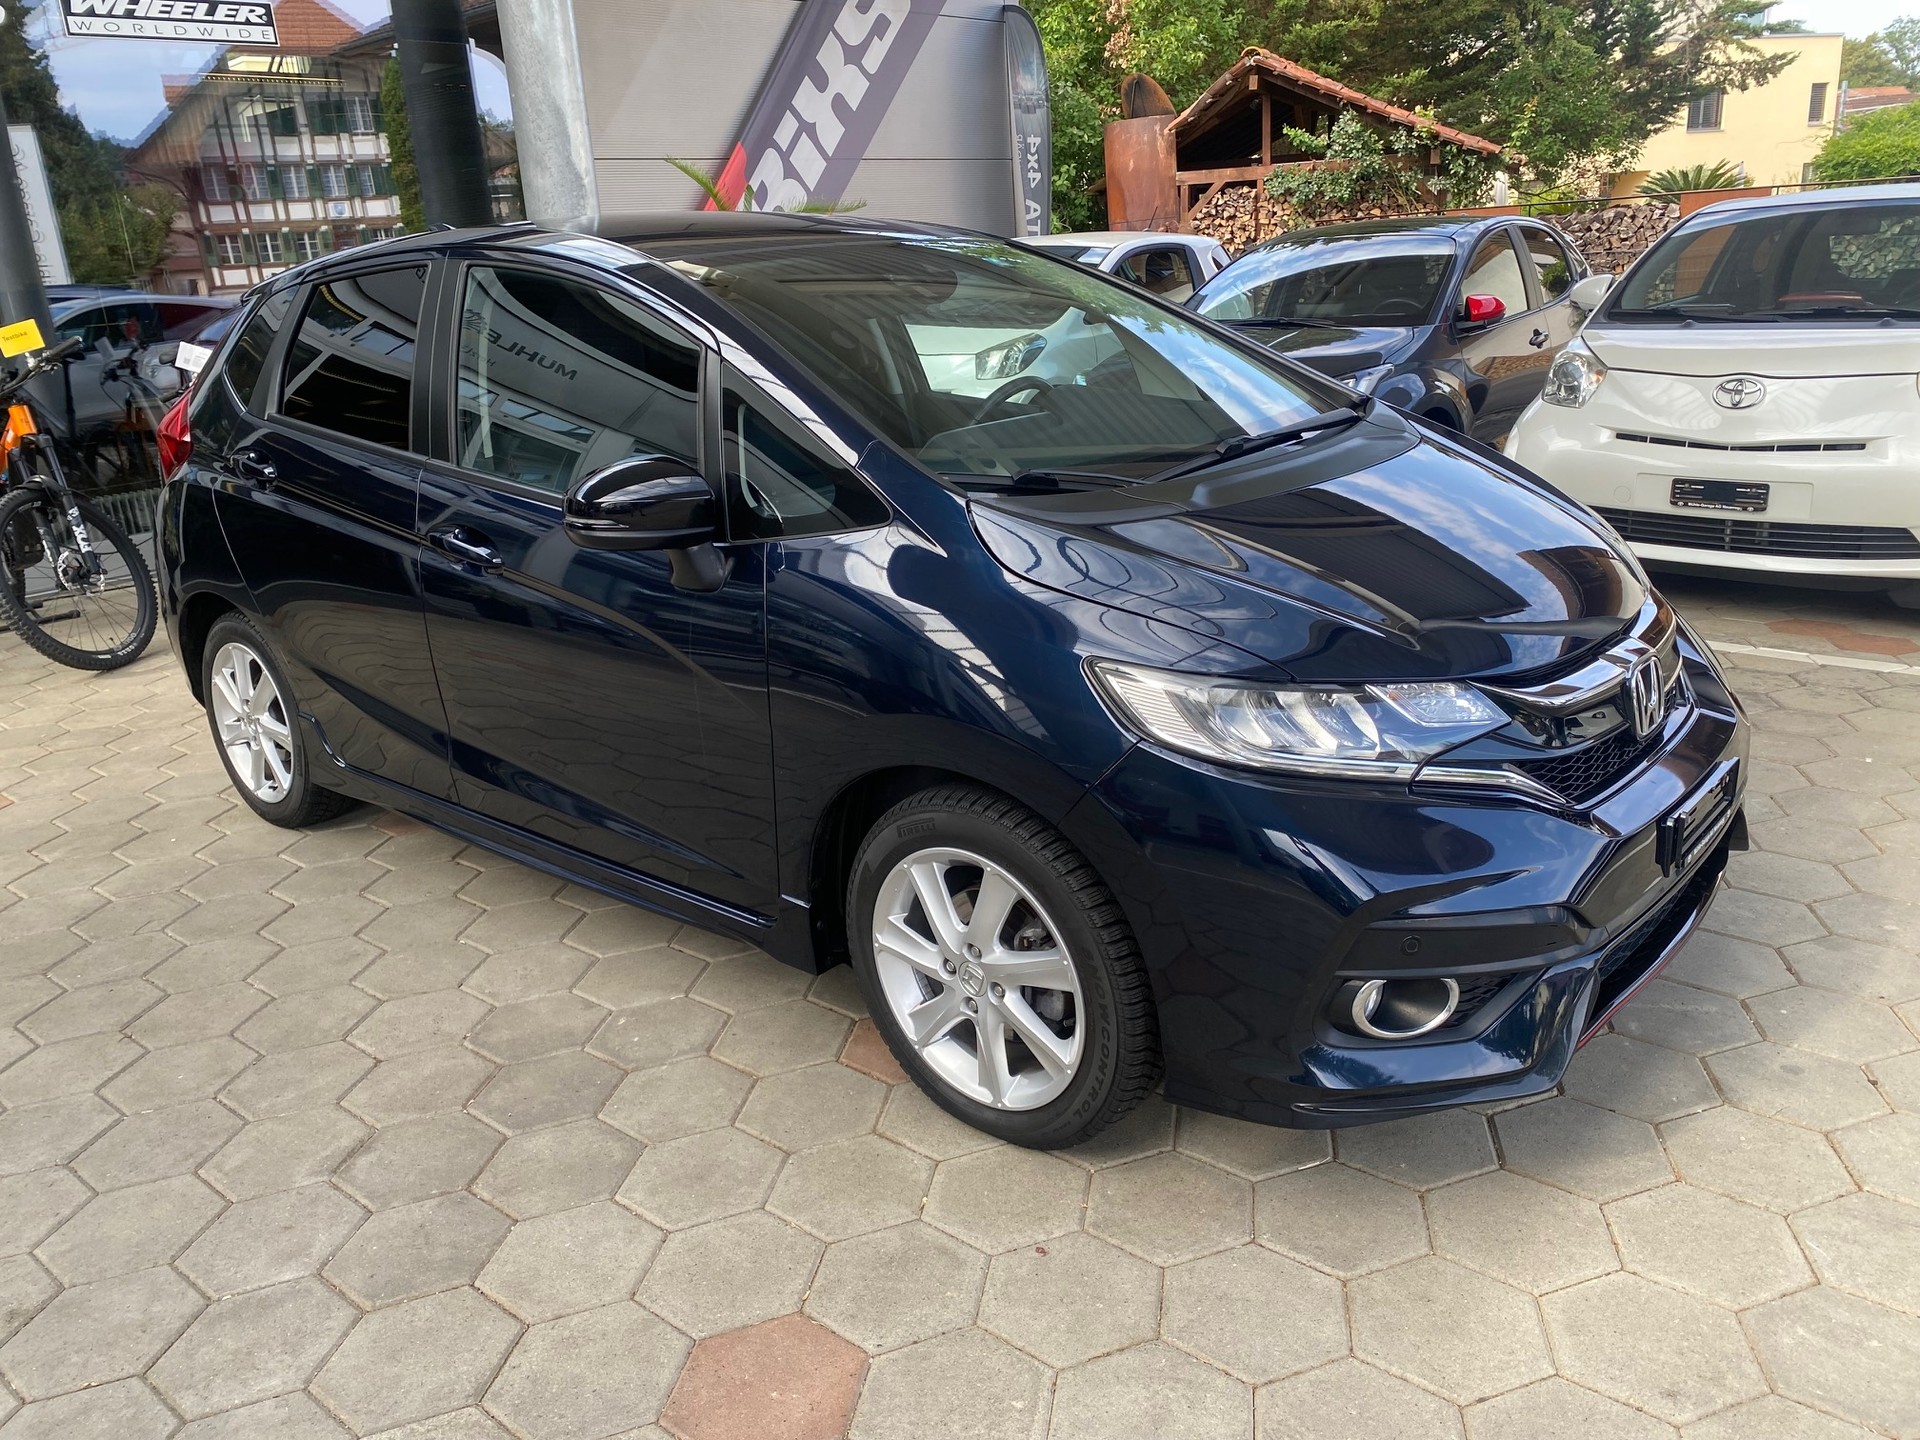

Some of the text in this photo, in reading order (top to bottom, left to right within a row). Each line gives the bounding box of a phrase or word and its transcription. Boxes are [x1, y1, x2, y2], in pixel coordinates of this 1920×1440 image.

[70, 0, 267, 24] WHEELER
[73, 20, 271, 40] WORLDWIDE
[897, 817, 936, 838] PIRELLI
